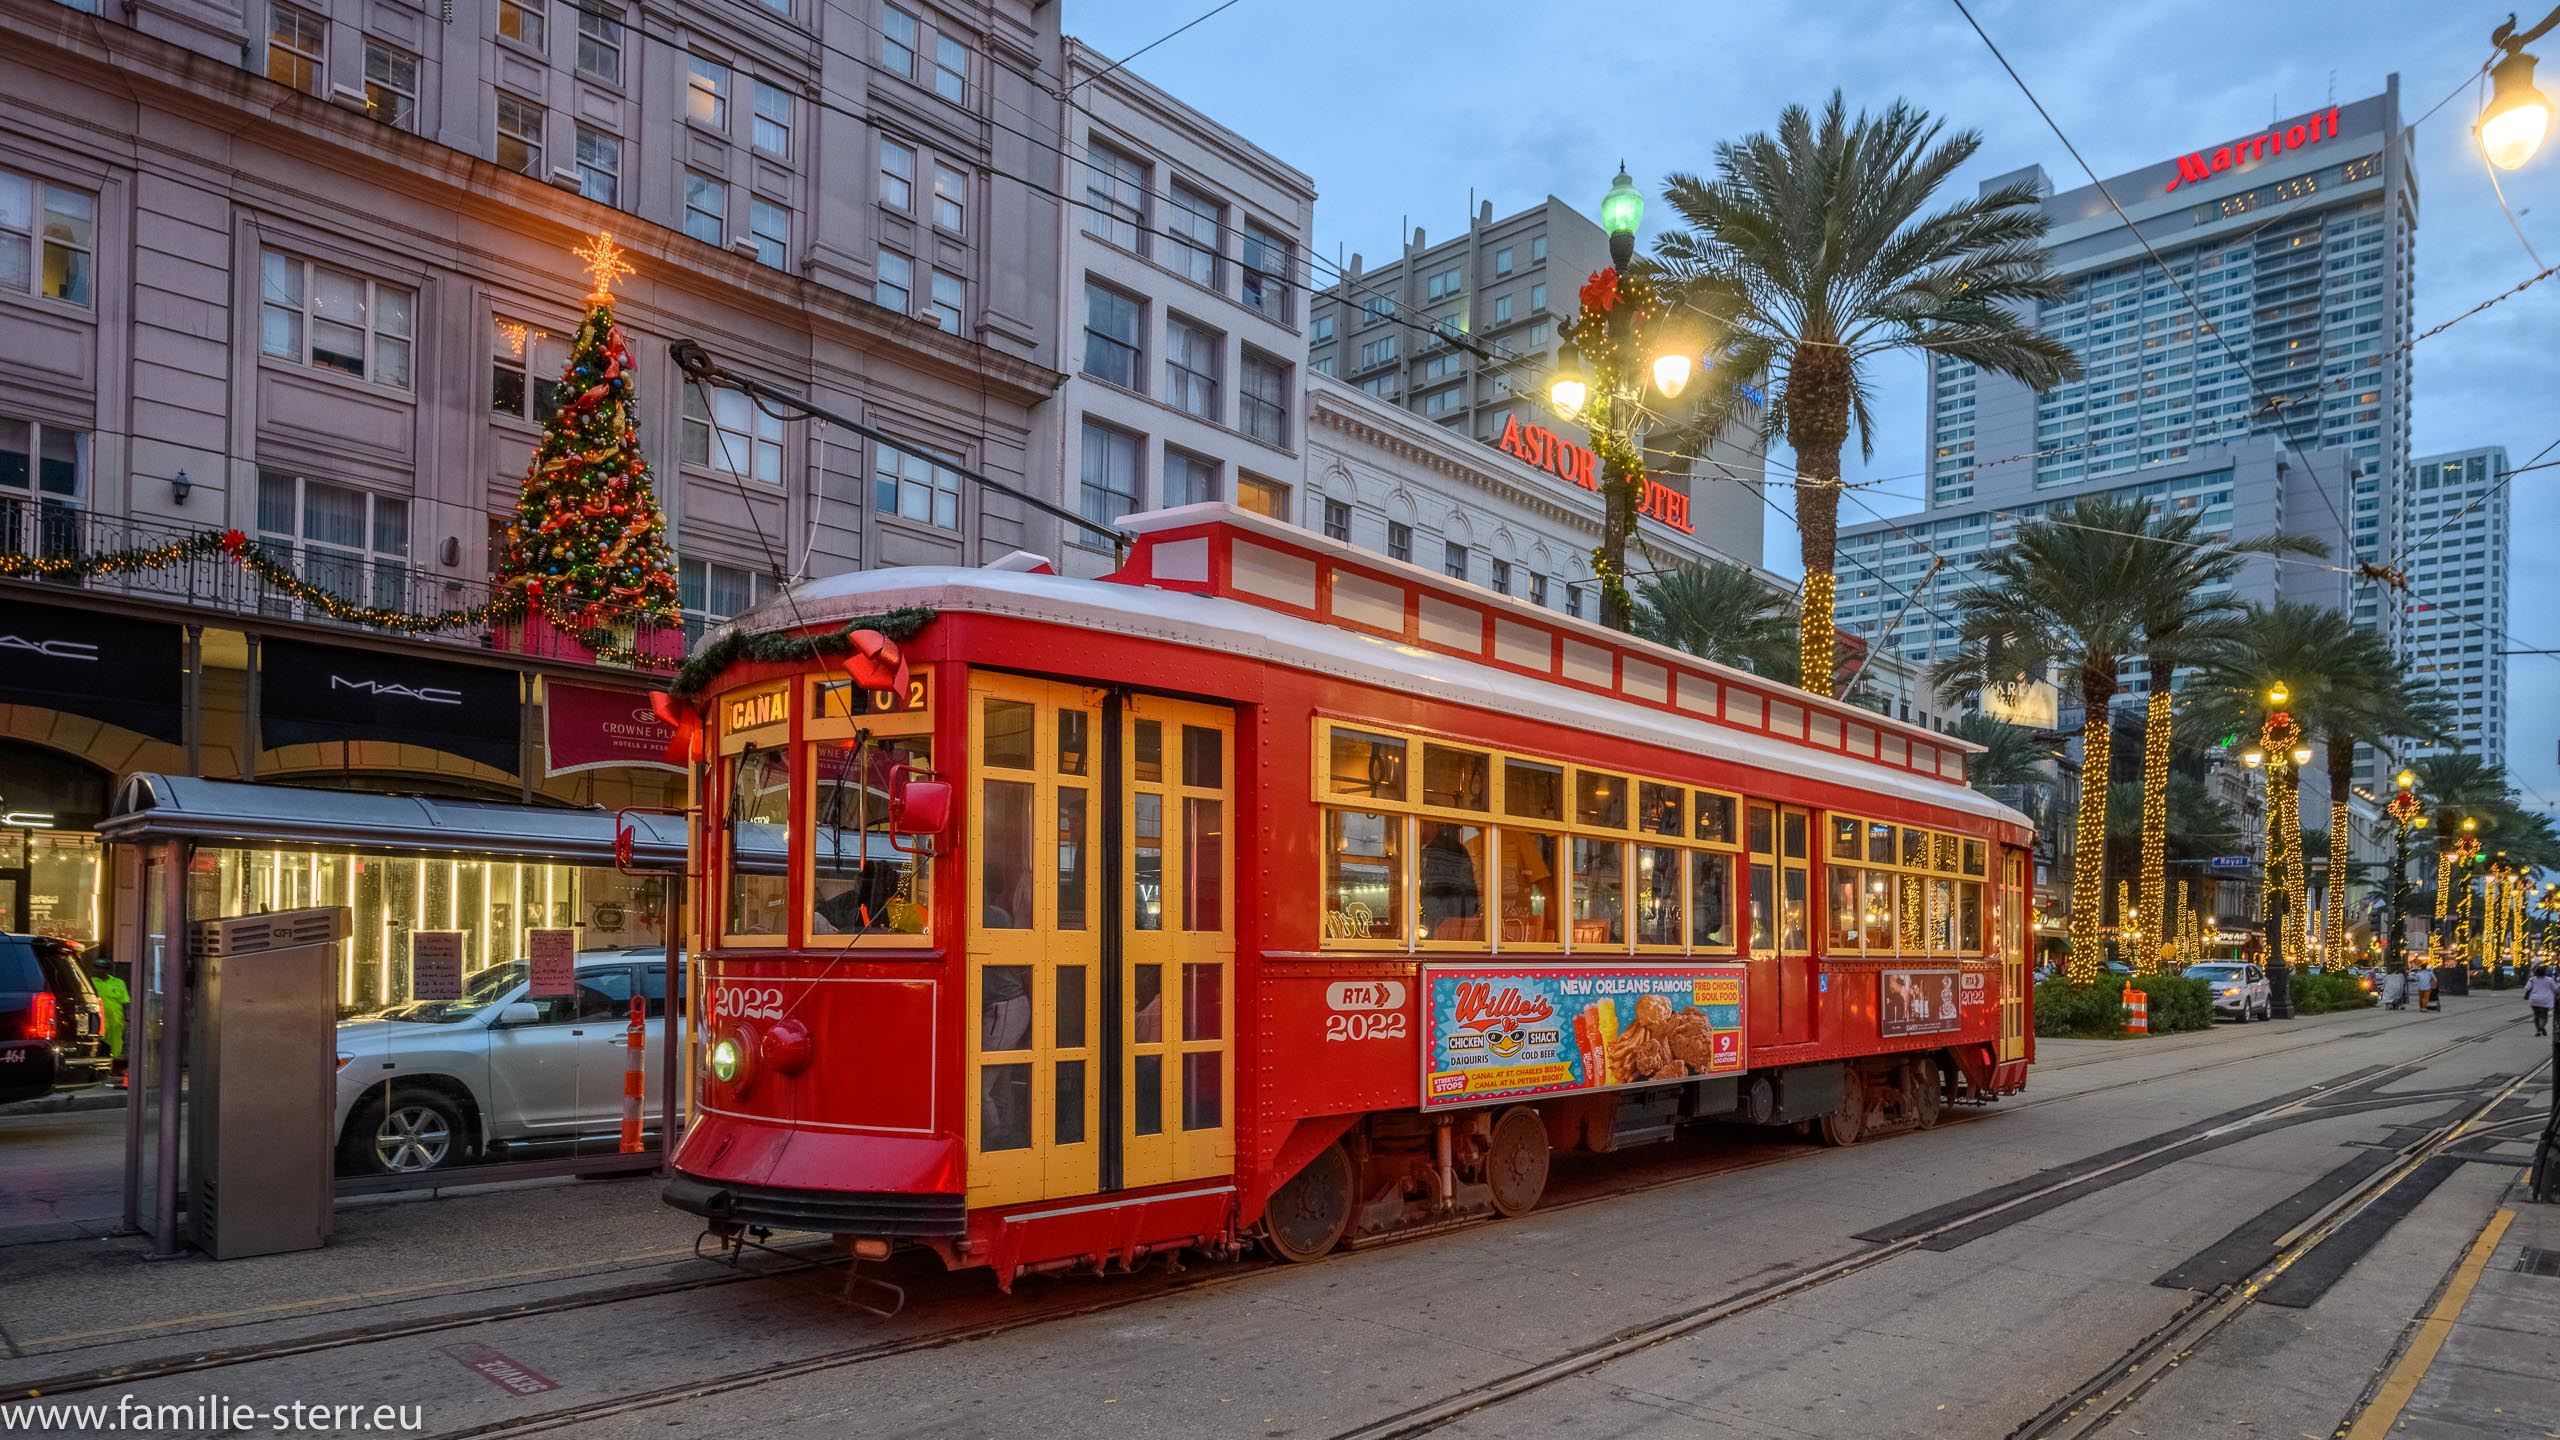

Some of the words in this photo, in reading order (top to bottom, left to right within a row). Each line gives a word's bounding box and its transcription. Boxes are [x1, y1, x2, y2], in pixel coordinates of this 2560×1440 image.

[2165, 106, 2339, 192] Marriott
[1500, 413, 1598, 491] ASTOR
[1625, 473, 1695, 534] OTEL
[602, 722, 651, 737] CROWNE
[657, 728, 676, 739] PLA
[613, 740, 640, 749] HOTELS
[2220, 857, 2243, 866] Royal
[1560, 980, 1592, 995] NEW
[1596, 979, 1650, 994] ORLEANS
[1652, 980, 1692, 993] FAMOUS
[1694, 982, 1711, 990] FRIED
[1712, 981, 1737, 990] CHICKEN
[1343, 988, 1371, 1004] RTA
[1455, 982, 1553, 1023] Willie's
[1702, 992, 1718, 1000] SOUL
[1720, 992, 1737, 1000] FOOD
[1961, 990, 1984, 1005] 2022
[716, 987, 784, 1020] 2022
[1326, 1013, 1406, 1042] 2022
[1450, 1036, 1484, 1049] CHICKEN
[1530, 1032, 1557, 1043] SHACK
[1721, 1036, 1730, 1051] 9
[1451, 1055, 1489, 1066] DAIQUIRIS
[1521, 1051, 1538, 1060] COLD
[1540, 1050, 1555, 1059] BEER
[1434, 1075, 1465, 1085] STREETCAR
[1472, 1072, 1494, 1080] CANAL
[1516, 1068, 1542, 1076] CHARLES
[1436, 1081, 1463, 1092] STOPS
[473, 1360, 548, 1393] SERVICE
